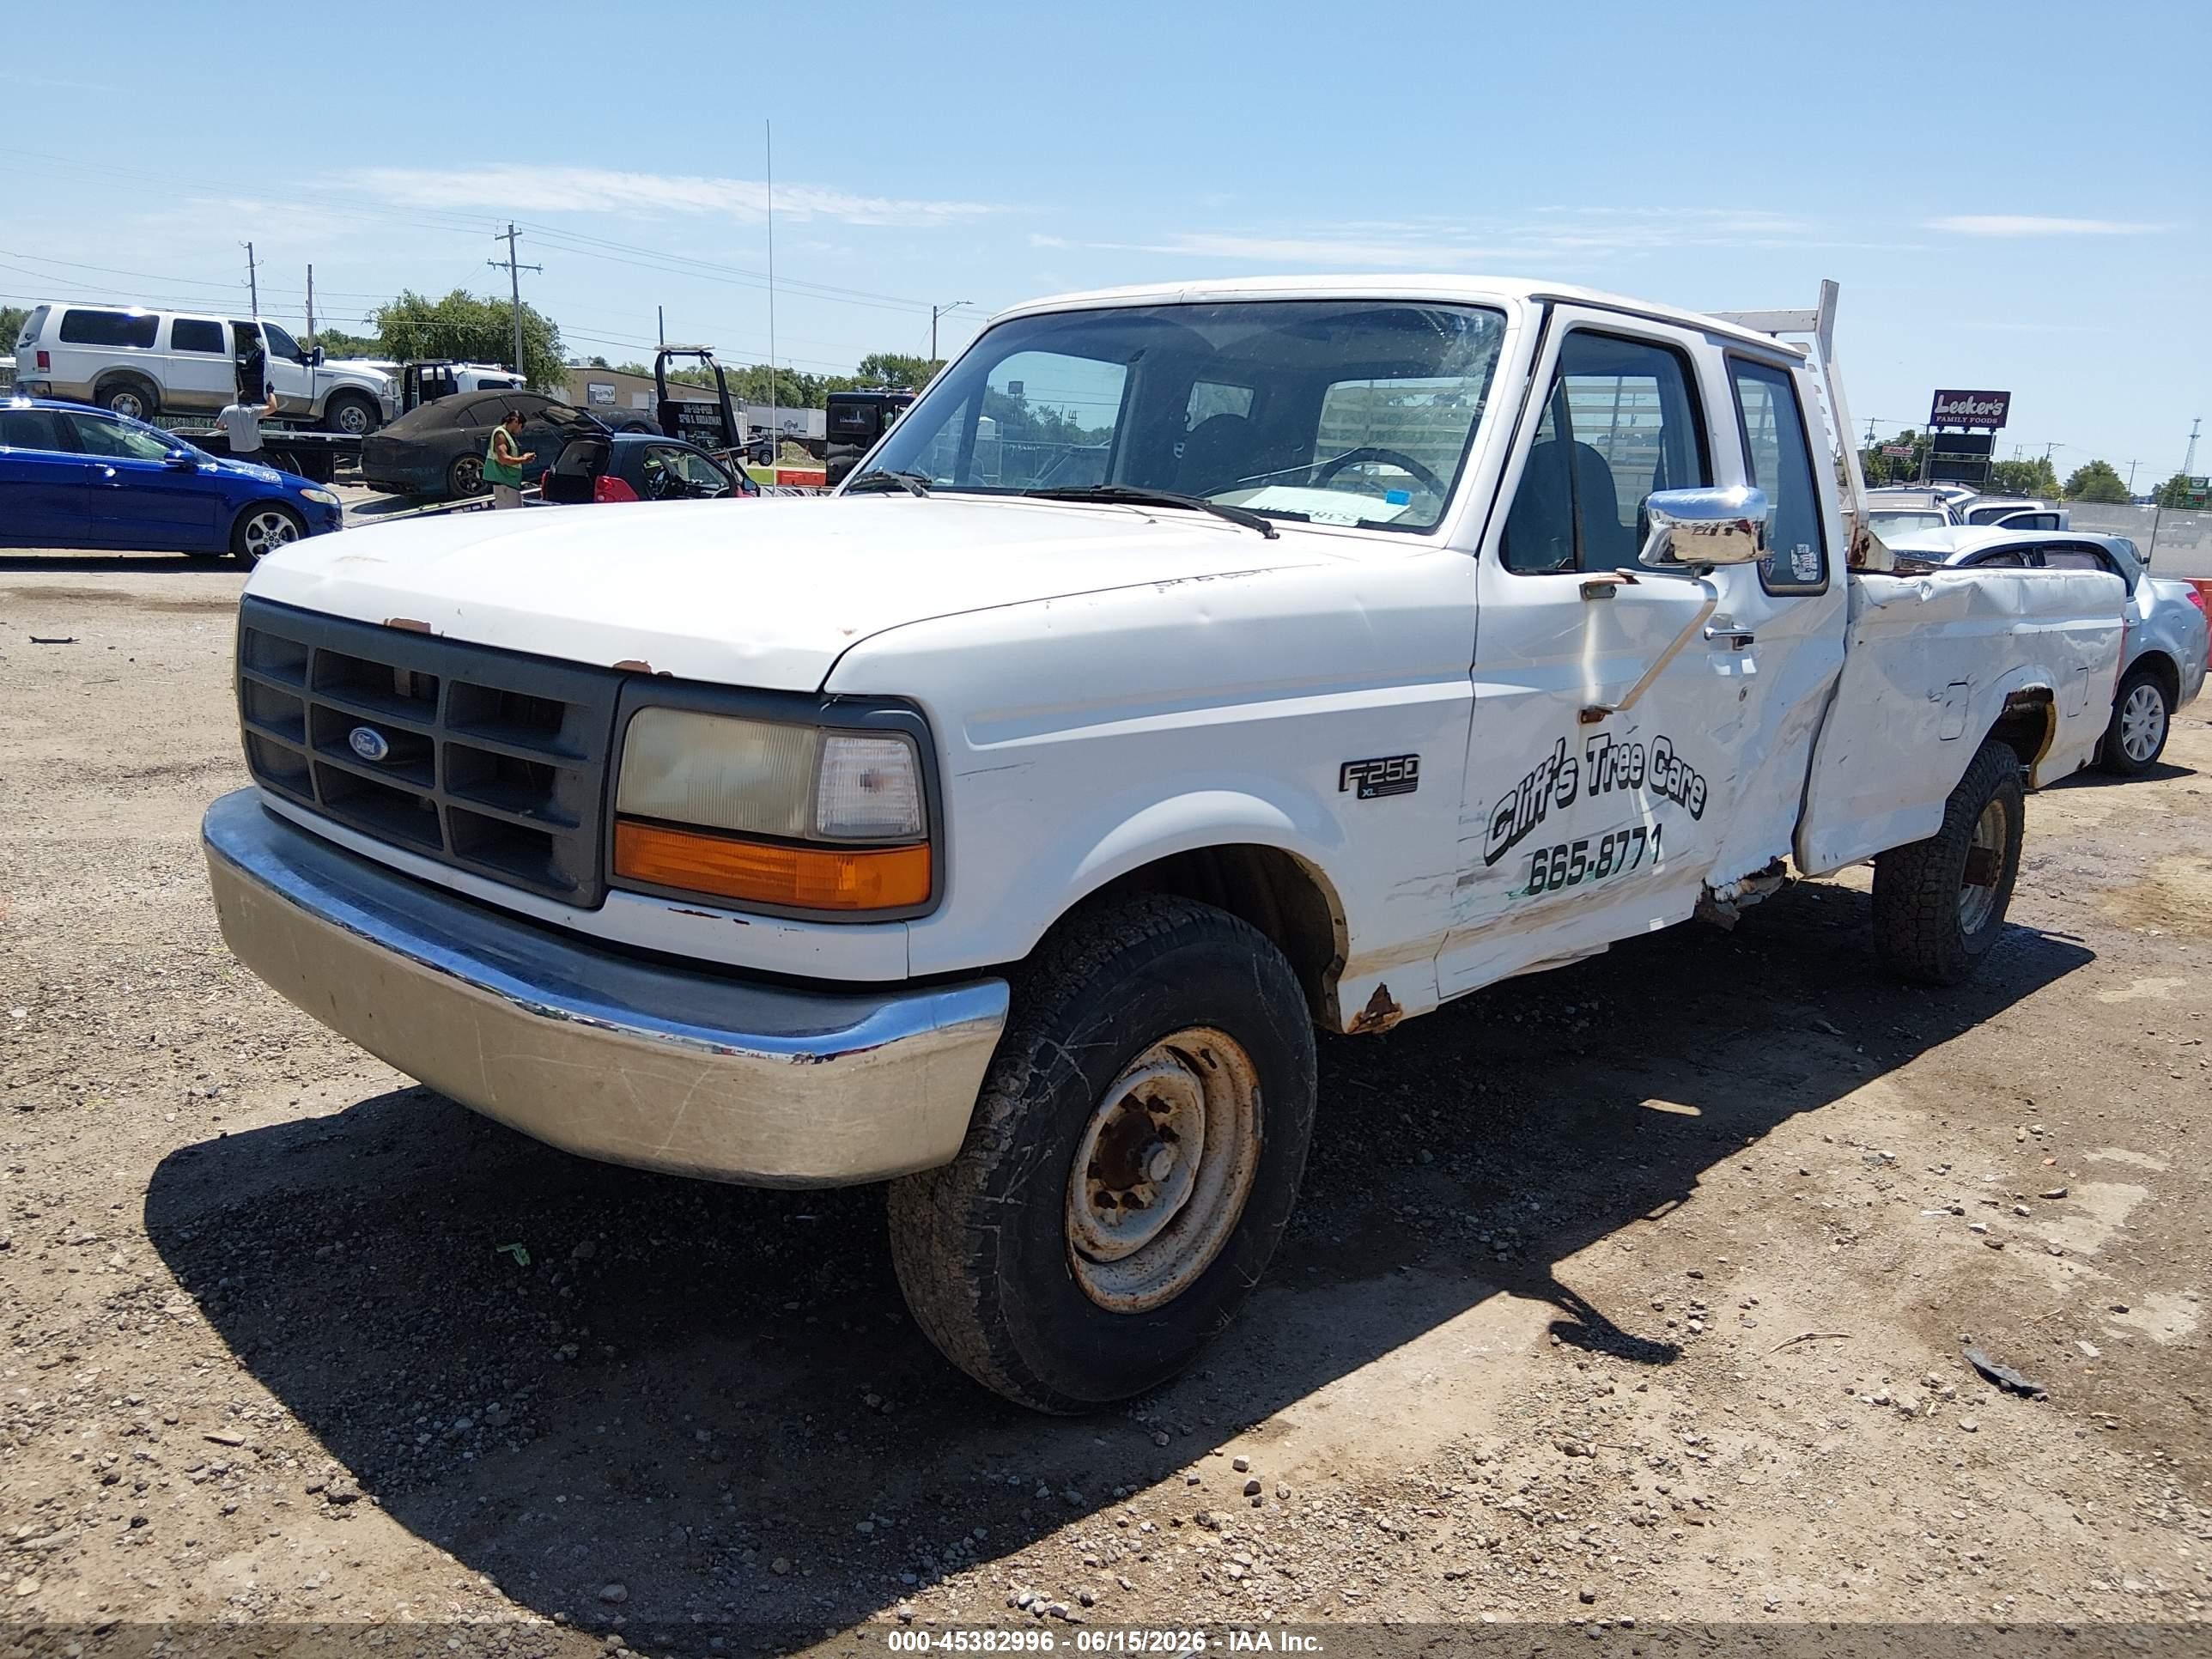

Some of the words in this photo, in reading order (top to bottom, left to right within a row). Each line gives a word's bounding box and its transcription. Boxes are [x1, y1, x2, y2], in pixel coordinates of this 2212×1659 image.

[1935, 394, 2003, 416] Leeker's
[356, 733, 376, 754] Ford
[1361, 788, 1376, 797] XL
[1484, 737, 1578, 866] Cliff's
[1586, 732, 1645, 797] Tree
[1648, 735, 1708, 821] Care
[1528, 823, 1662, 896] 665-8771
